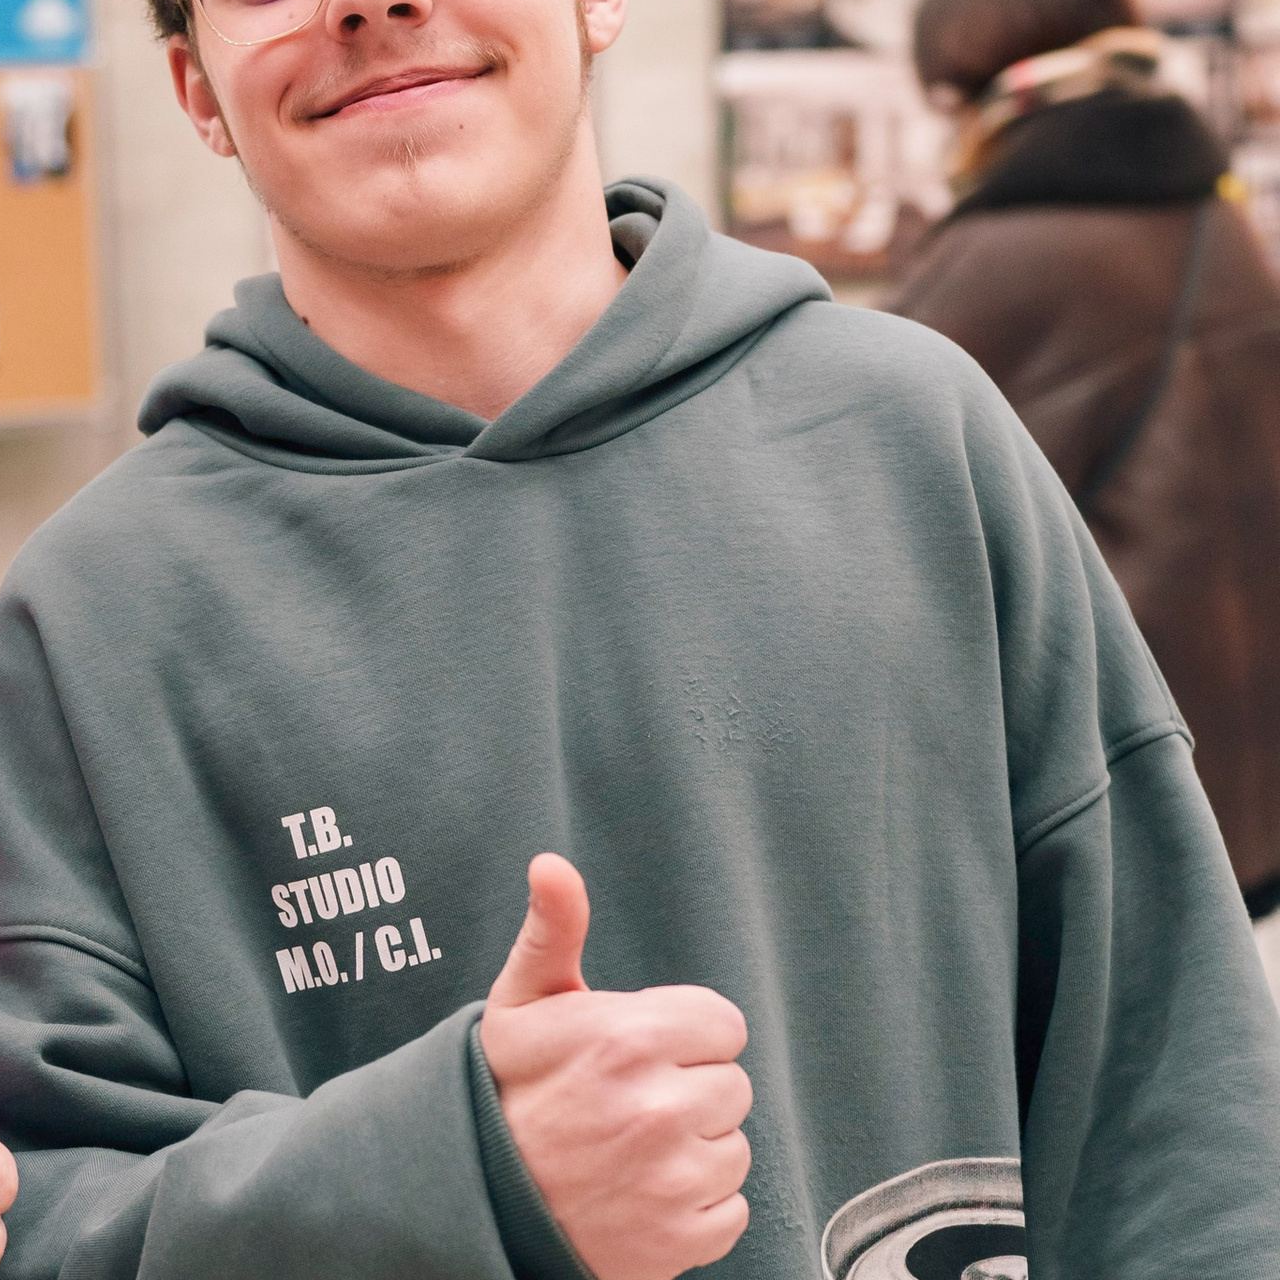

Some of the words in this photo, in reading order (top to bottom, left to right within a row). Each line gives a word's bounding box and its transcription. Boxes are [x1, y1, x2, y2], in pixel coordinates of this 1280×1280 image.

[281, 806, 353, 859] T.B.
[271, 856, 406, 928] STUDIO
[275, 941, 348, 994] M.O.
[374, 917, 442, 972] C.I.
